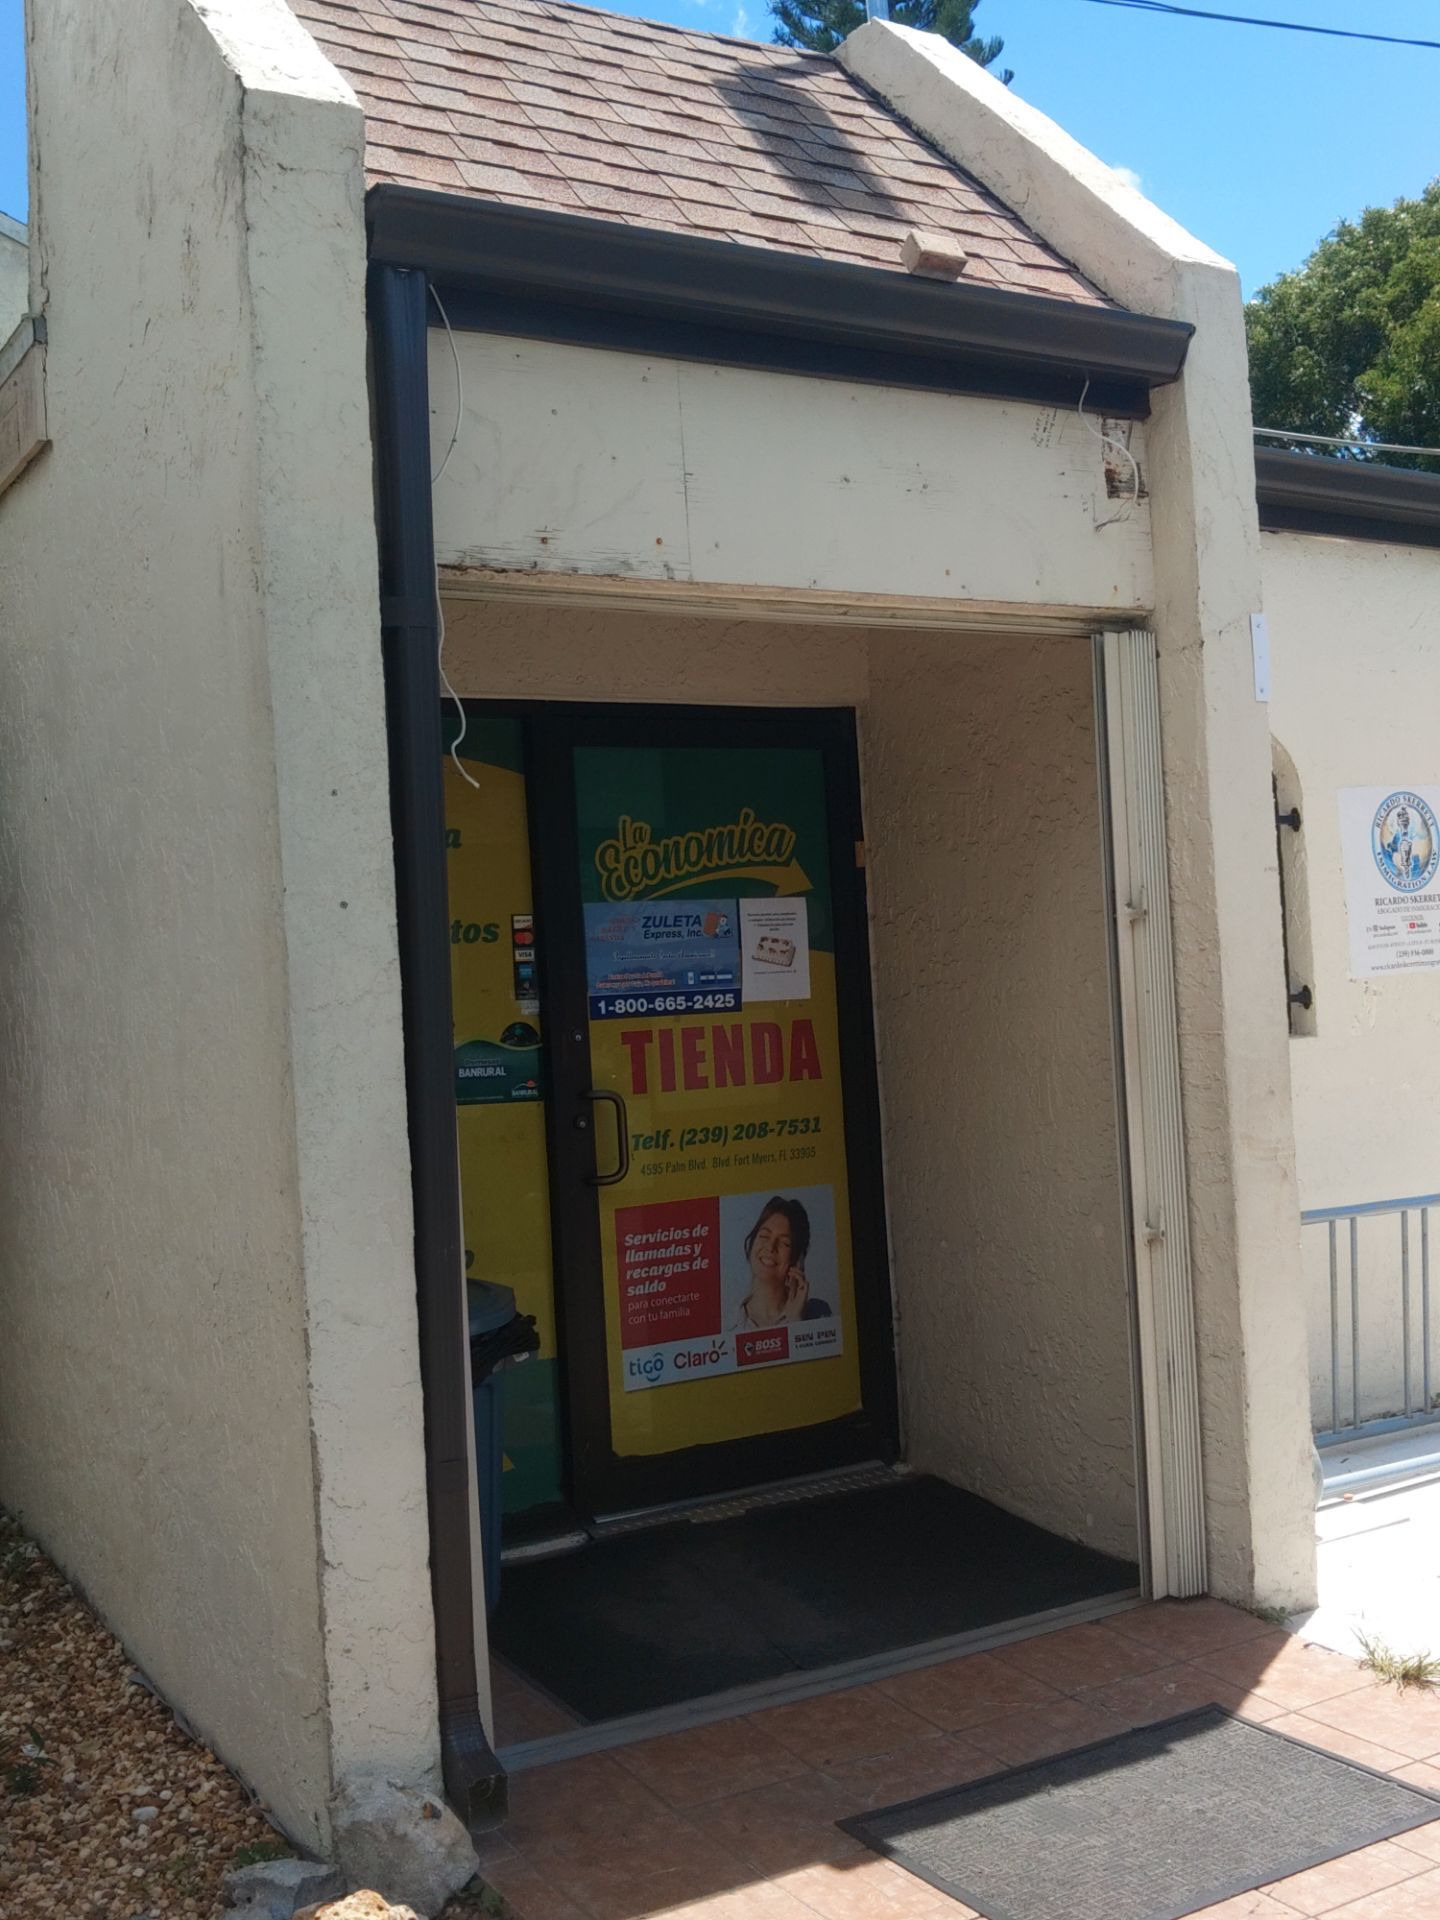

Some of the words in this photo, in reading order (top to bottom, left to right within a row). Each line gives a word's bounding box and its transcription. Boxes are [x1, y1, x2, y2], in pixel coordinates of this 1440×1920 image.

[1375, 796, 1401, 829] RICARDO
[1403, 795, 1435, 828] SKERRETT
[619, 815, 651, 852] La
[595, 807, 797, 902] Economica
[1377, 851, 1427, 889] IMMIGRATION
[1375, 896, 1409, 906] RICARDO
[641, 914, 703, 929] ZULETA
[644, 929, 685, 941] Express,
[687, 928, 704, 938] Inc.
[597, 993, 736, 1015] 1-800-665-2425
[621, 1019, 822, 1095] TIENDA
[458, 1066, 507, 1078] BANRURAL
[632, 1129, 674, 1151] Telf.
[680, 1125, 729, 1151] (239)
[732, 1116, 822, 1142] 208-7531
[640, 1162, 663, 1176] 4595
[665, 1160, 686, 1173] Palm
[734, 1154, 750, 1166] Fort
[751, 1152, 777, 1165] Myers,
[779, 1150, 788, 1161] FL
[624, 1227, 691, 1247] Servicios
[692, 1223, 710, 1238] de
[625, 1243, 692, 1263] llamadas
[694, 1242, 703, 1257] y
[626, 1260, 691, 1280] recargas
[692, 1257, 710, 1270] de
[627, 1279, 667, 1297] saldo
[628, 1300, 649, 1313] para
[651, 1291, 701, 1306] conectarte
[628, 1314, 646, 1325] con
[648, 1311, 658, 1322] tu
[659, 1306, 691, 1320] familia
[755, 1337, 783, 1351] BOSS
[794, 1333, 814, 1343] SIN
[817, 1329, 837, 1339] PIN
[673, 1348, 720, 1370] Claro
